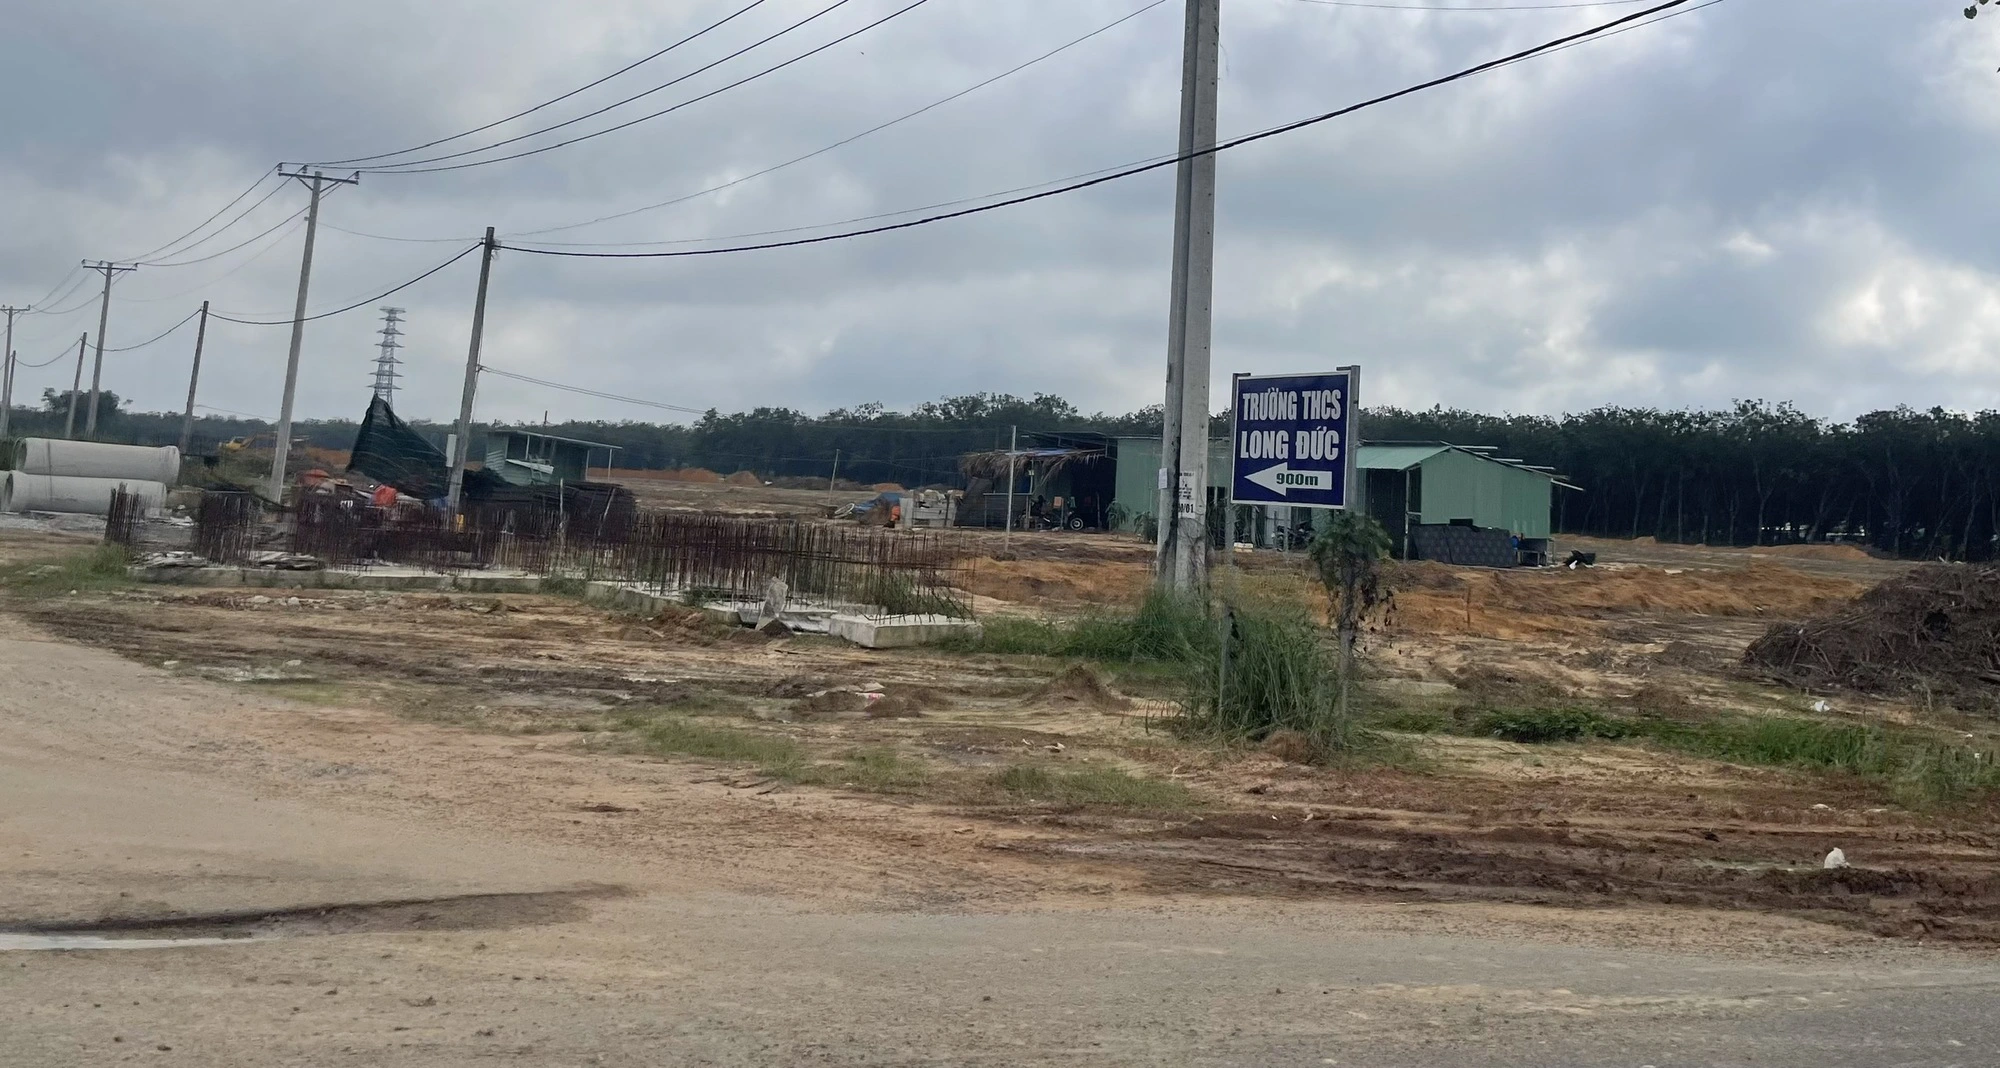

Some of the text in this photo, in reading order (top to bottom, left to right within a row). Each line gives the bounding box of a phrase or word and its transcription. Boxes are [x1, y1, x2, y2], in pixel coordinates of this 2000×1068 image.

[1243, 387, 1341, 421] TRƯỜNG THCS
[1240, 426, 1340, 461] LONG ĐỨC
[1276, 473, 1319, 486] 900m
